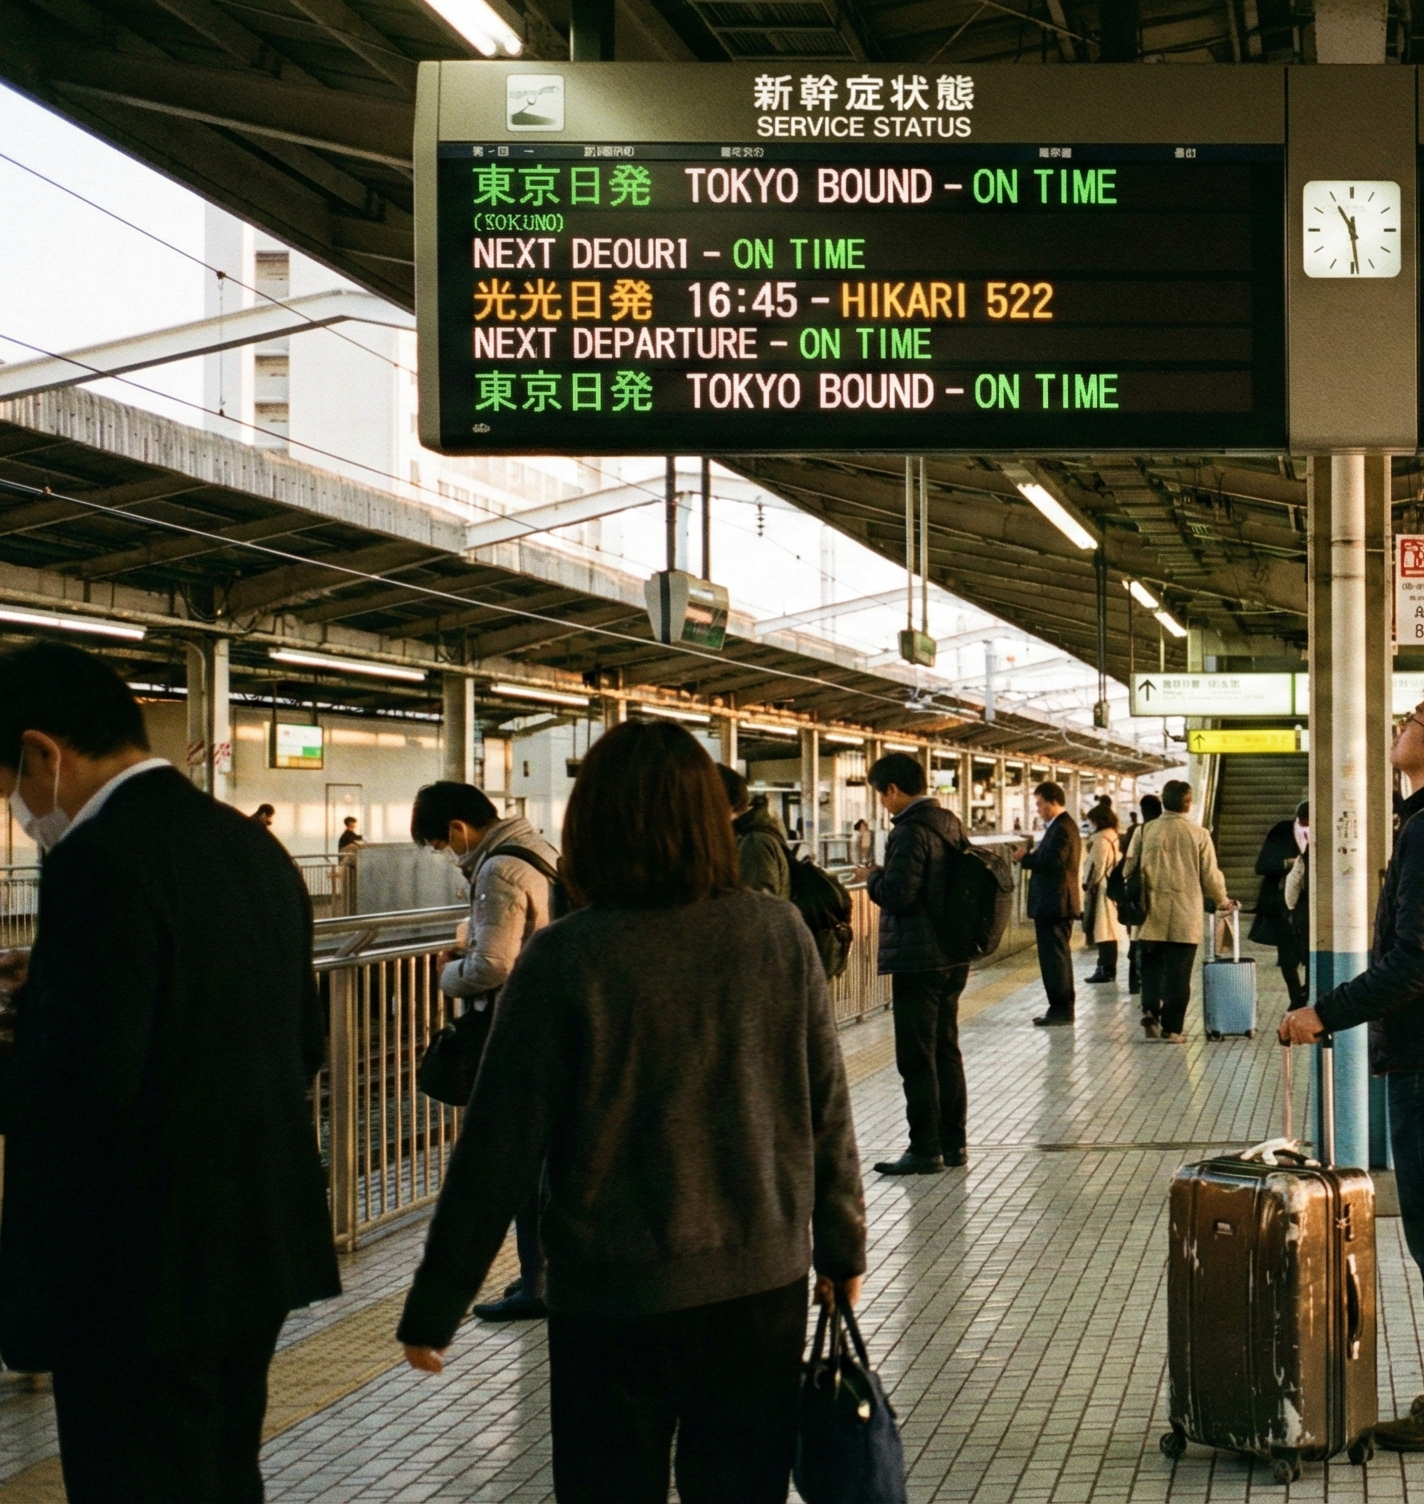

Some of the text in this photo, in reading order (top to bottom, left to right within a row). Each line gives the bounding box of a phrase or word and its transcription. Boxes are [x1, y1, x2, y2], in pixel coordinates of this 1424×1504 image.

[757, 116, 972, 138] SERVICE STATUS
[472, 162, 653, 207] 東京日発
[684, 167, 799, 204] TOKYO
[817, 167, 933, 204] BOUND
[973, 168, 1018, 204] ON
[1033, 168, 1118, 204] TIME
[473, 237, 557, 269] NEXT
[733, 238, 774, 270] ON
[789, 238, 866, 270] TIME
[473, 278, 654, 322] 光光日発
[688, 281, 798, 318] 16:45
[841, 281, 966, 319] HIKARI
[986, 282, 1054, 319] 522
[474, 326, 558, 359] NEXT
[573, 326, 758, 359] DEPARTURE
[799, 327, 841, 360] ON
[855, 327, 932, 360] TIME
[475, 369, 653, 412] 東京日発
[686, 372, 801, 409] TOKYO
[819, 372, 935, 409] BOUND
[974, 373, 1020, 409] ON
[1034, 372, 1119, 409] TIME
